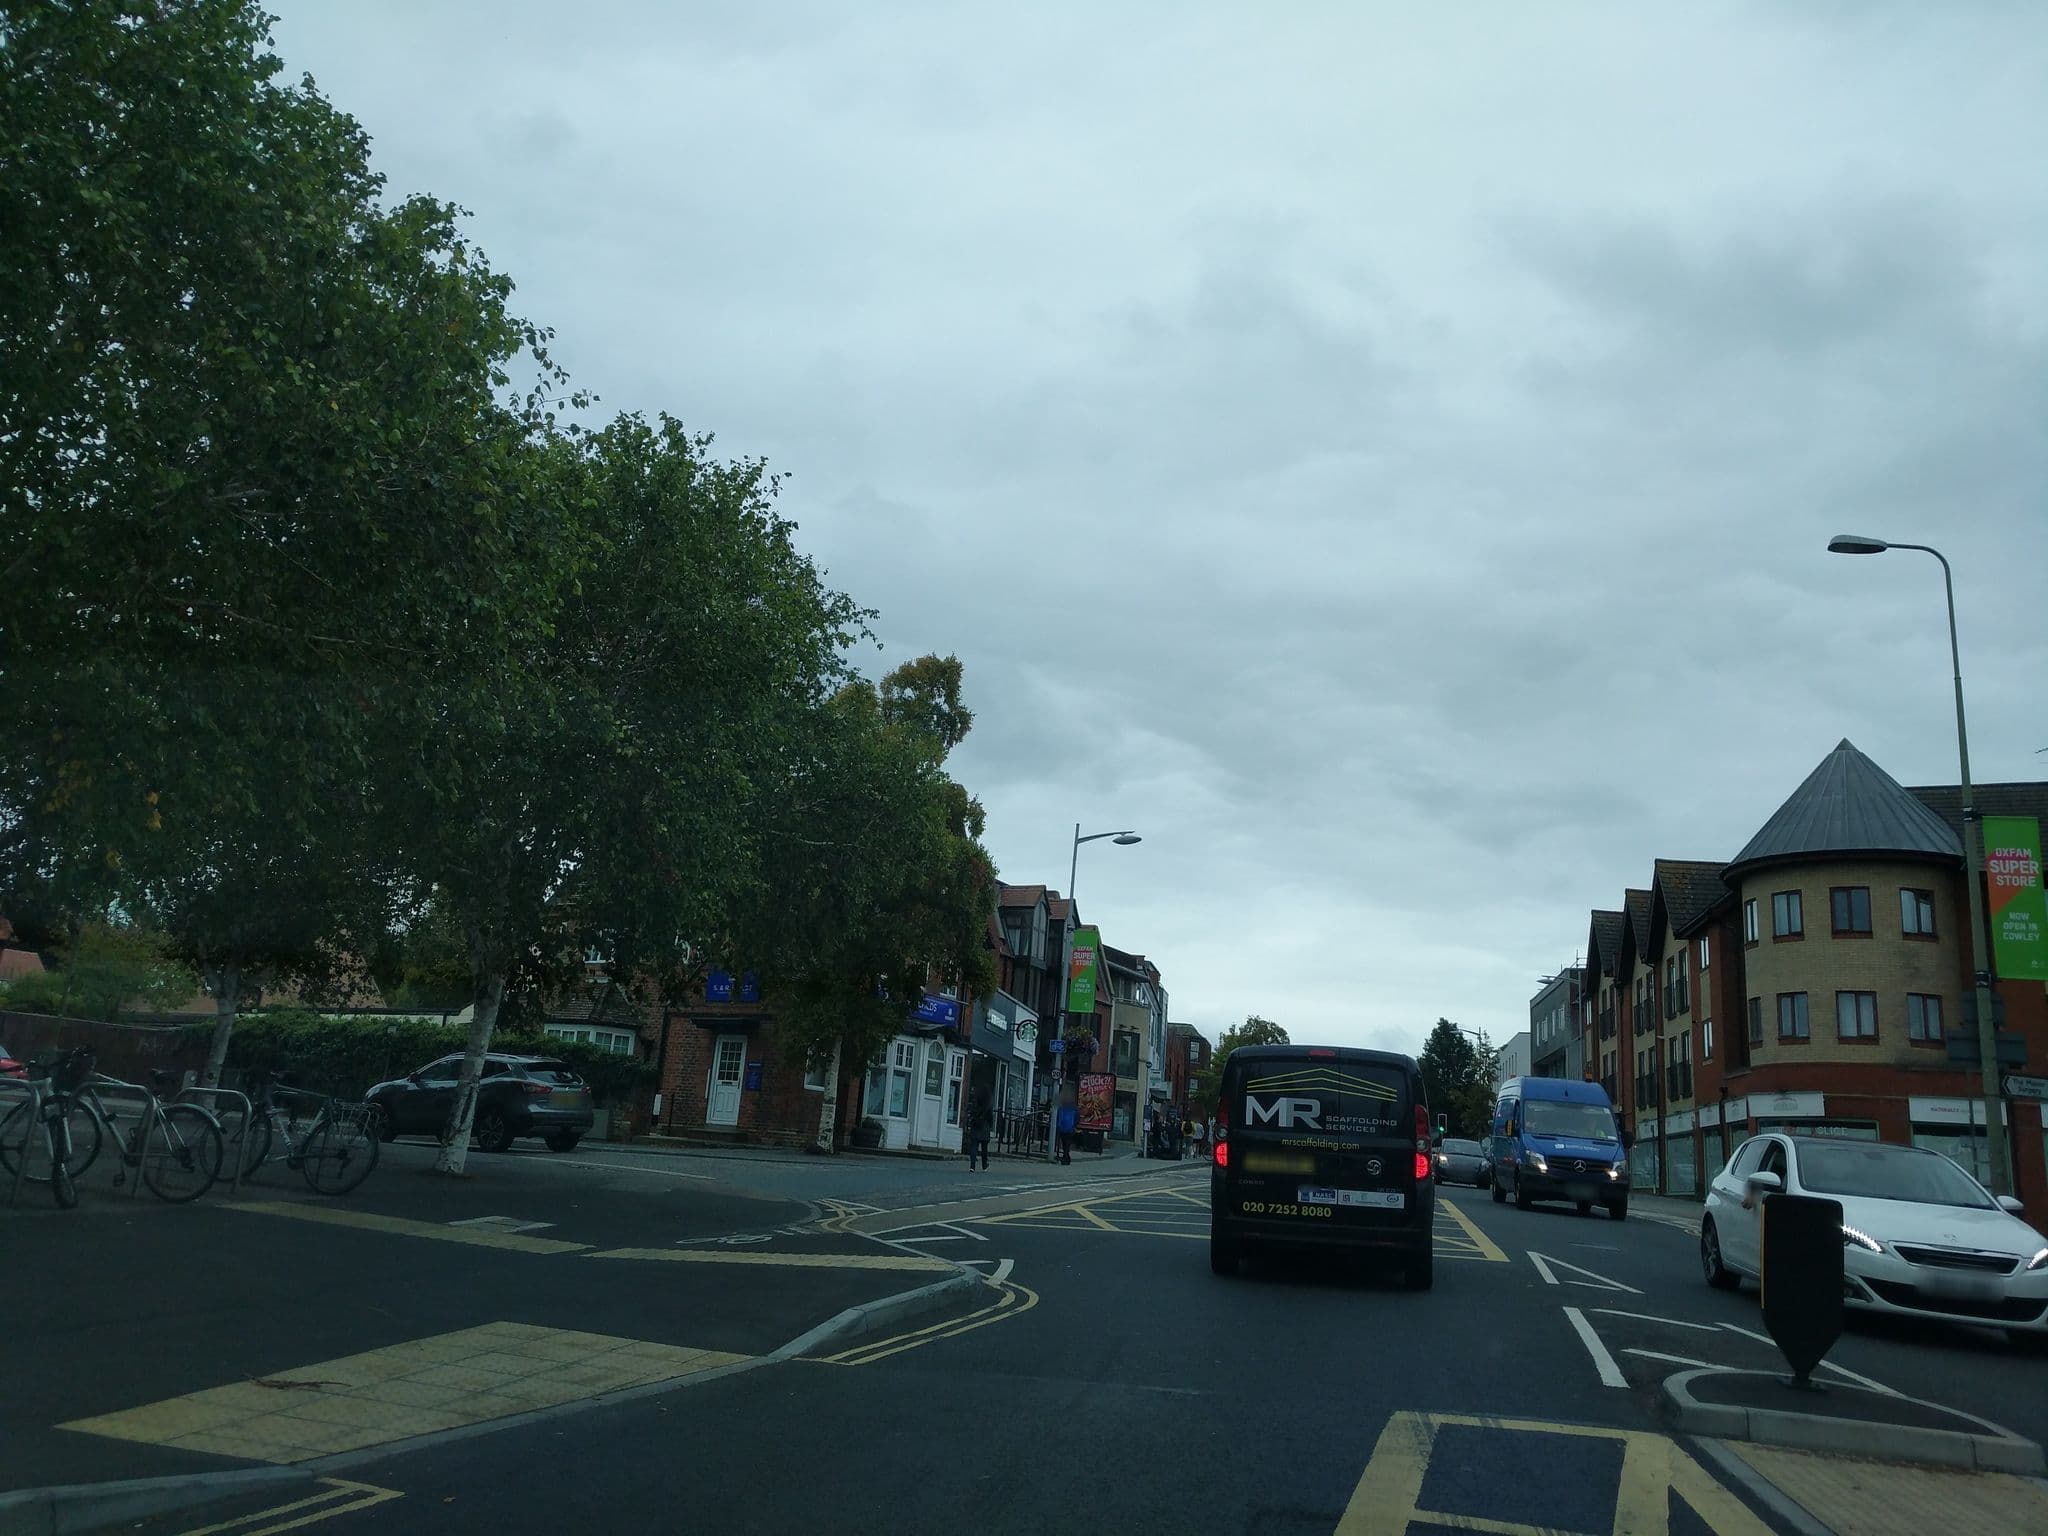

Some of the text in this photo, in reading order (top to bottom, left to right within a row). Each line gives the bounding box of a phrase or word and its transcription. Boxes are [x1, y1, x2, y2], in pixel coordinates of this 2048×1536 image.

[1995, 847, 2032, 858] OXFAM
[1989, 859, 2040, 874] SUPER
[1996, 875, 2037, 887] STORE
[2008, 911, 2030, 920] NOW
[2003, 921, 2037, 930] OPEN IN
[2003, 932, 2040, 942] COWLEY
[1073, 952, 1096, 960] SUPER
[1245, 1095, 1324, 1130] MR
[1326, 1115, 1398, 1127] SCAFFOLDING
[1326, 1123, 1376, 1133] SERVICES
[1281, 1136, 1361, 1151] mrscaffolding.com
[1242, 1202, 1333, 1218] 020 7252 8080
